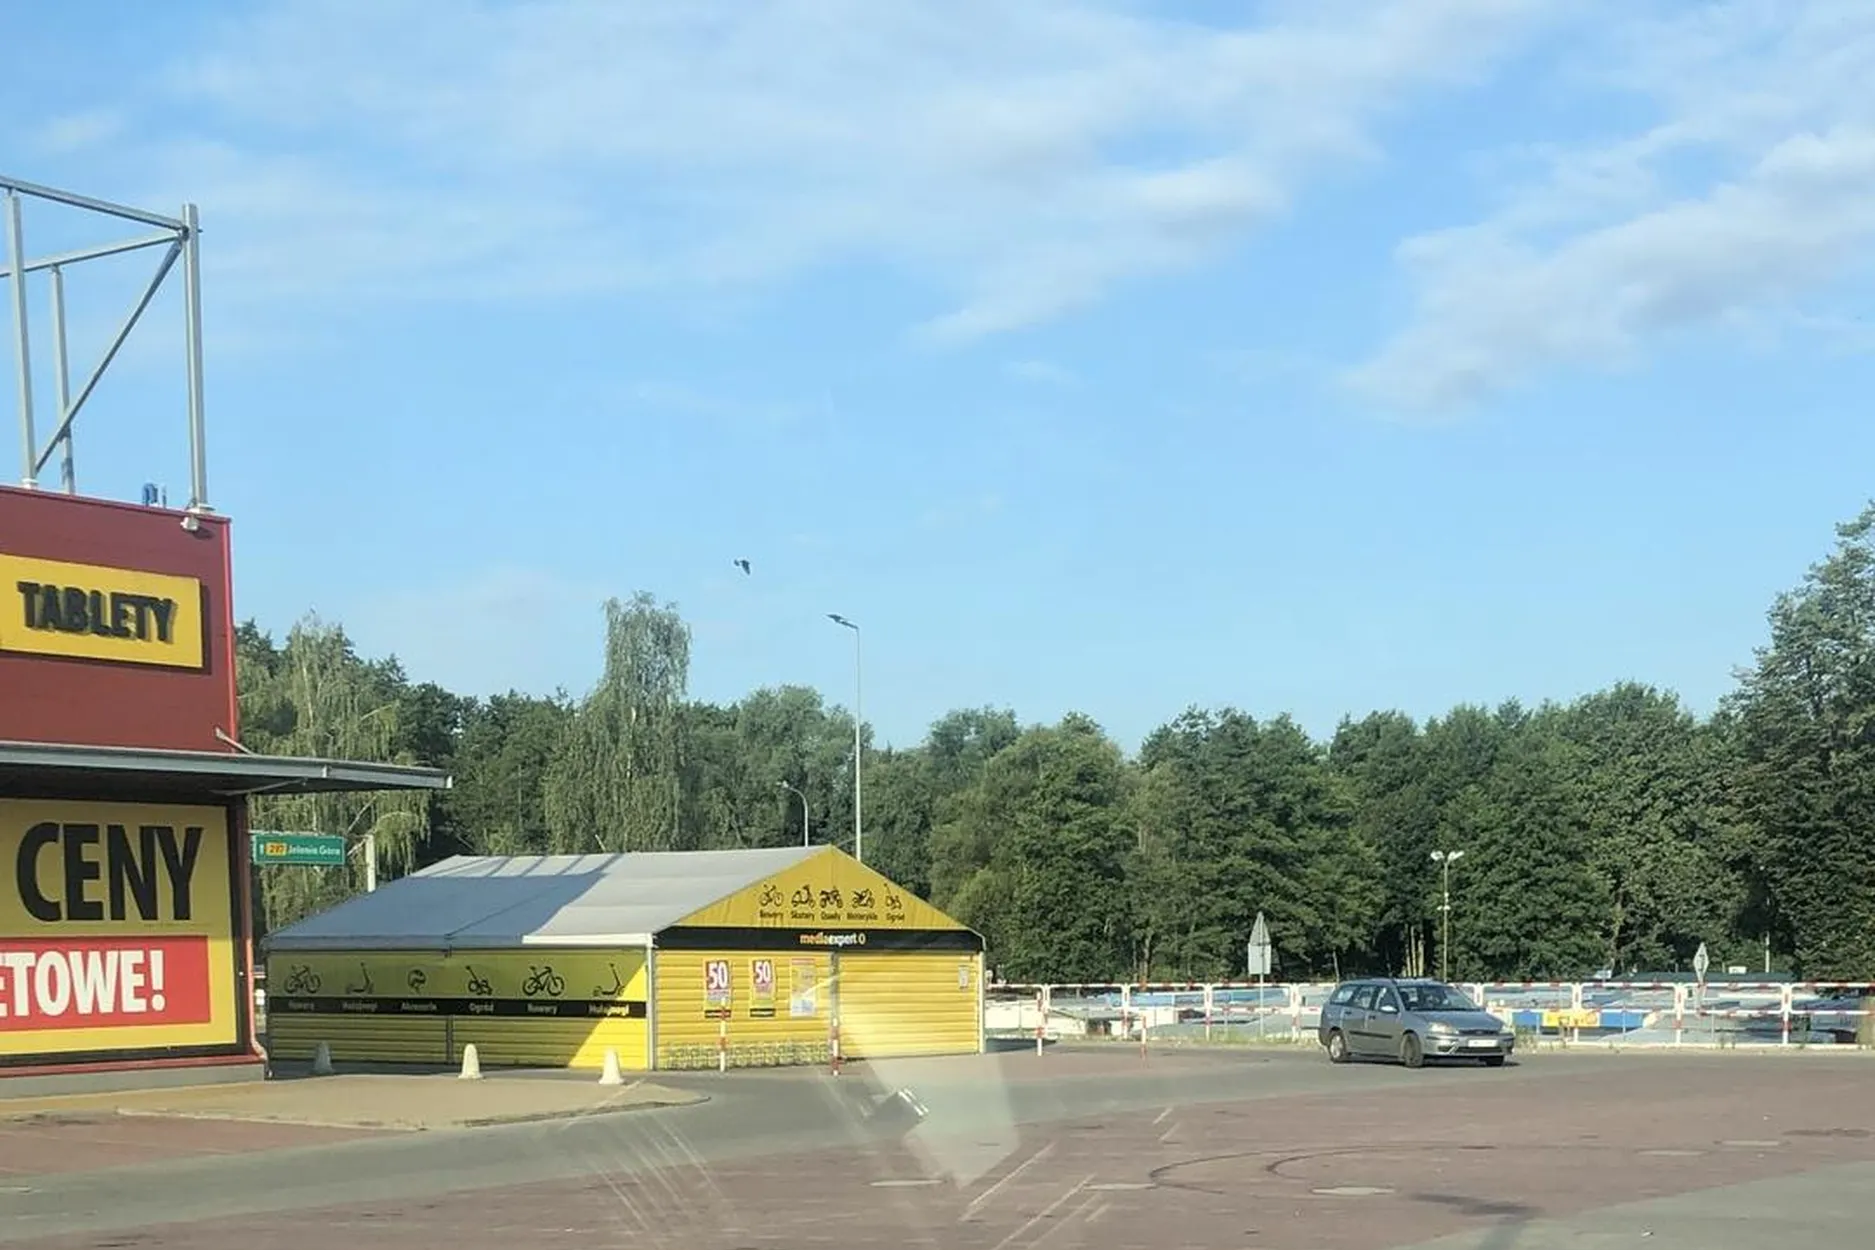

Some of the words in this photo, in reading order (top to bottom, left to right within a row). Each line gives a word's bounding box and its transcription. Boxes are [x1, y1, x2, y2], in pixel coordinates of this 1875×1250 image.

[17, 580, 176, 643] TABLETY
[16, 822, 204, 922] CENY
[708, 961, 728, 989] 50
[755, 960, 771, 984] 50
